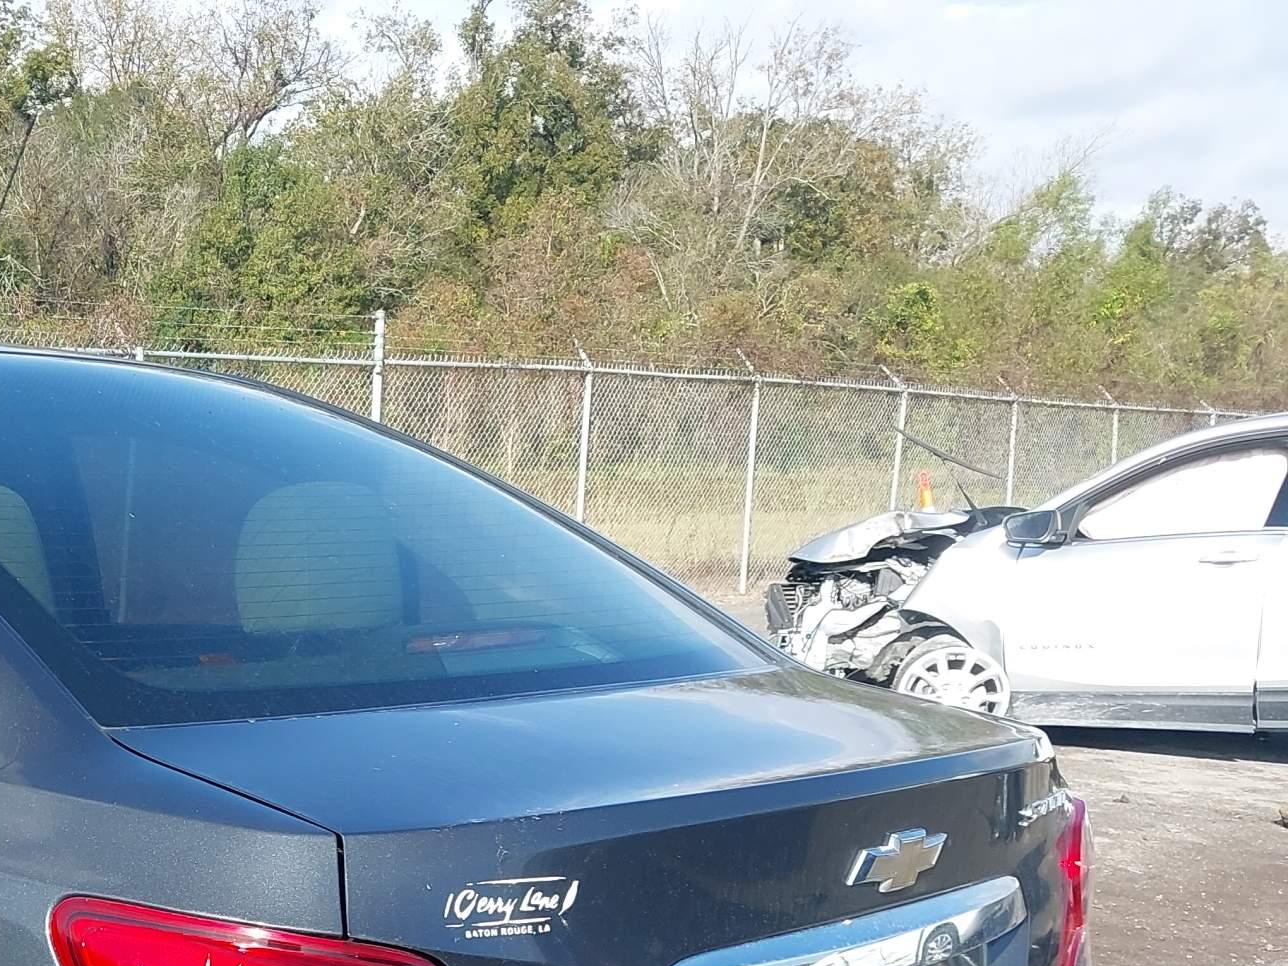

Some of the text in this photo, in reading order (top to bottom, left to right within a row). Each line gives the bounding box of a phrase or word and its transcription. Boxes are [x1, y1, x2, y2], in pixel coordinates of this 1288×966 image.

[520, 886, 560, 911] Lane
[465, 927, 498, 939] BATON
[538, 924, 551, 933] LA
